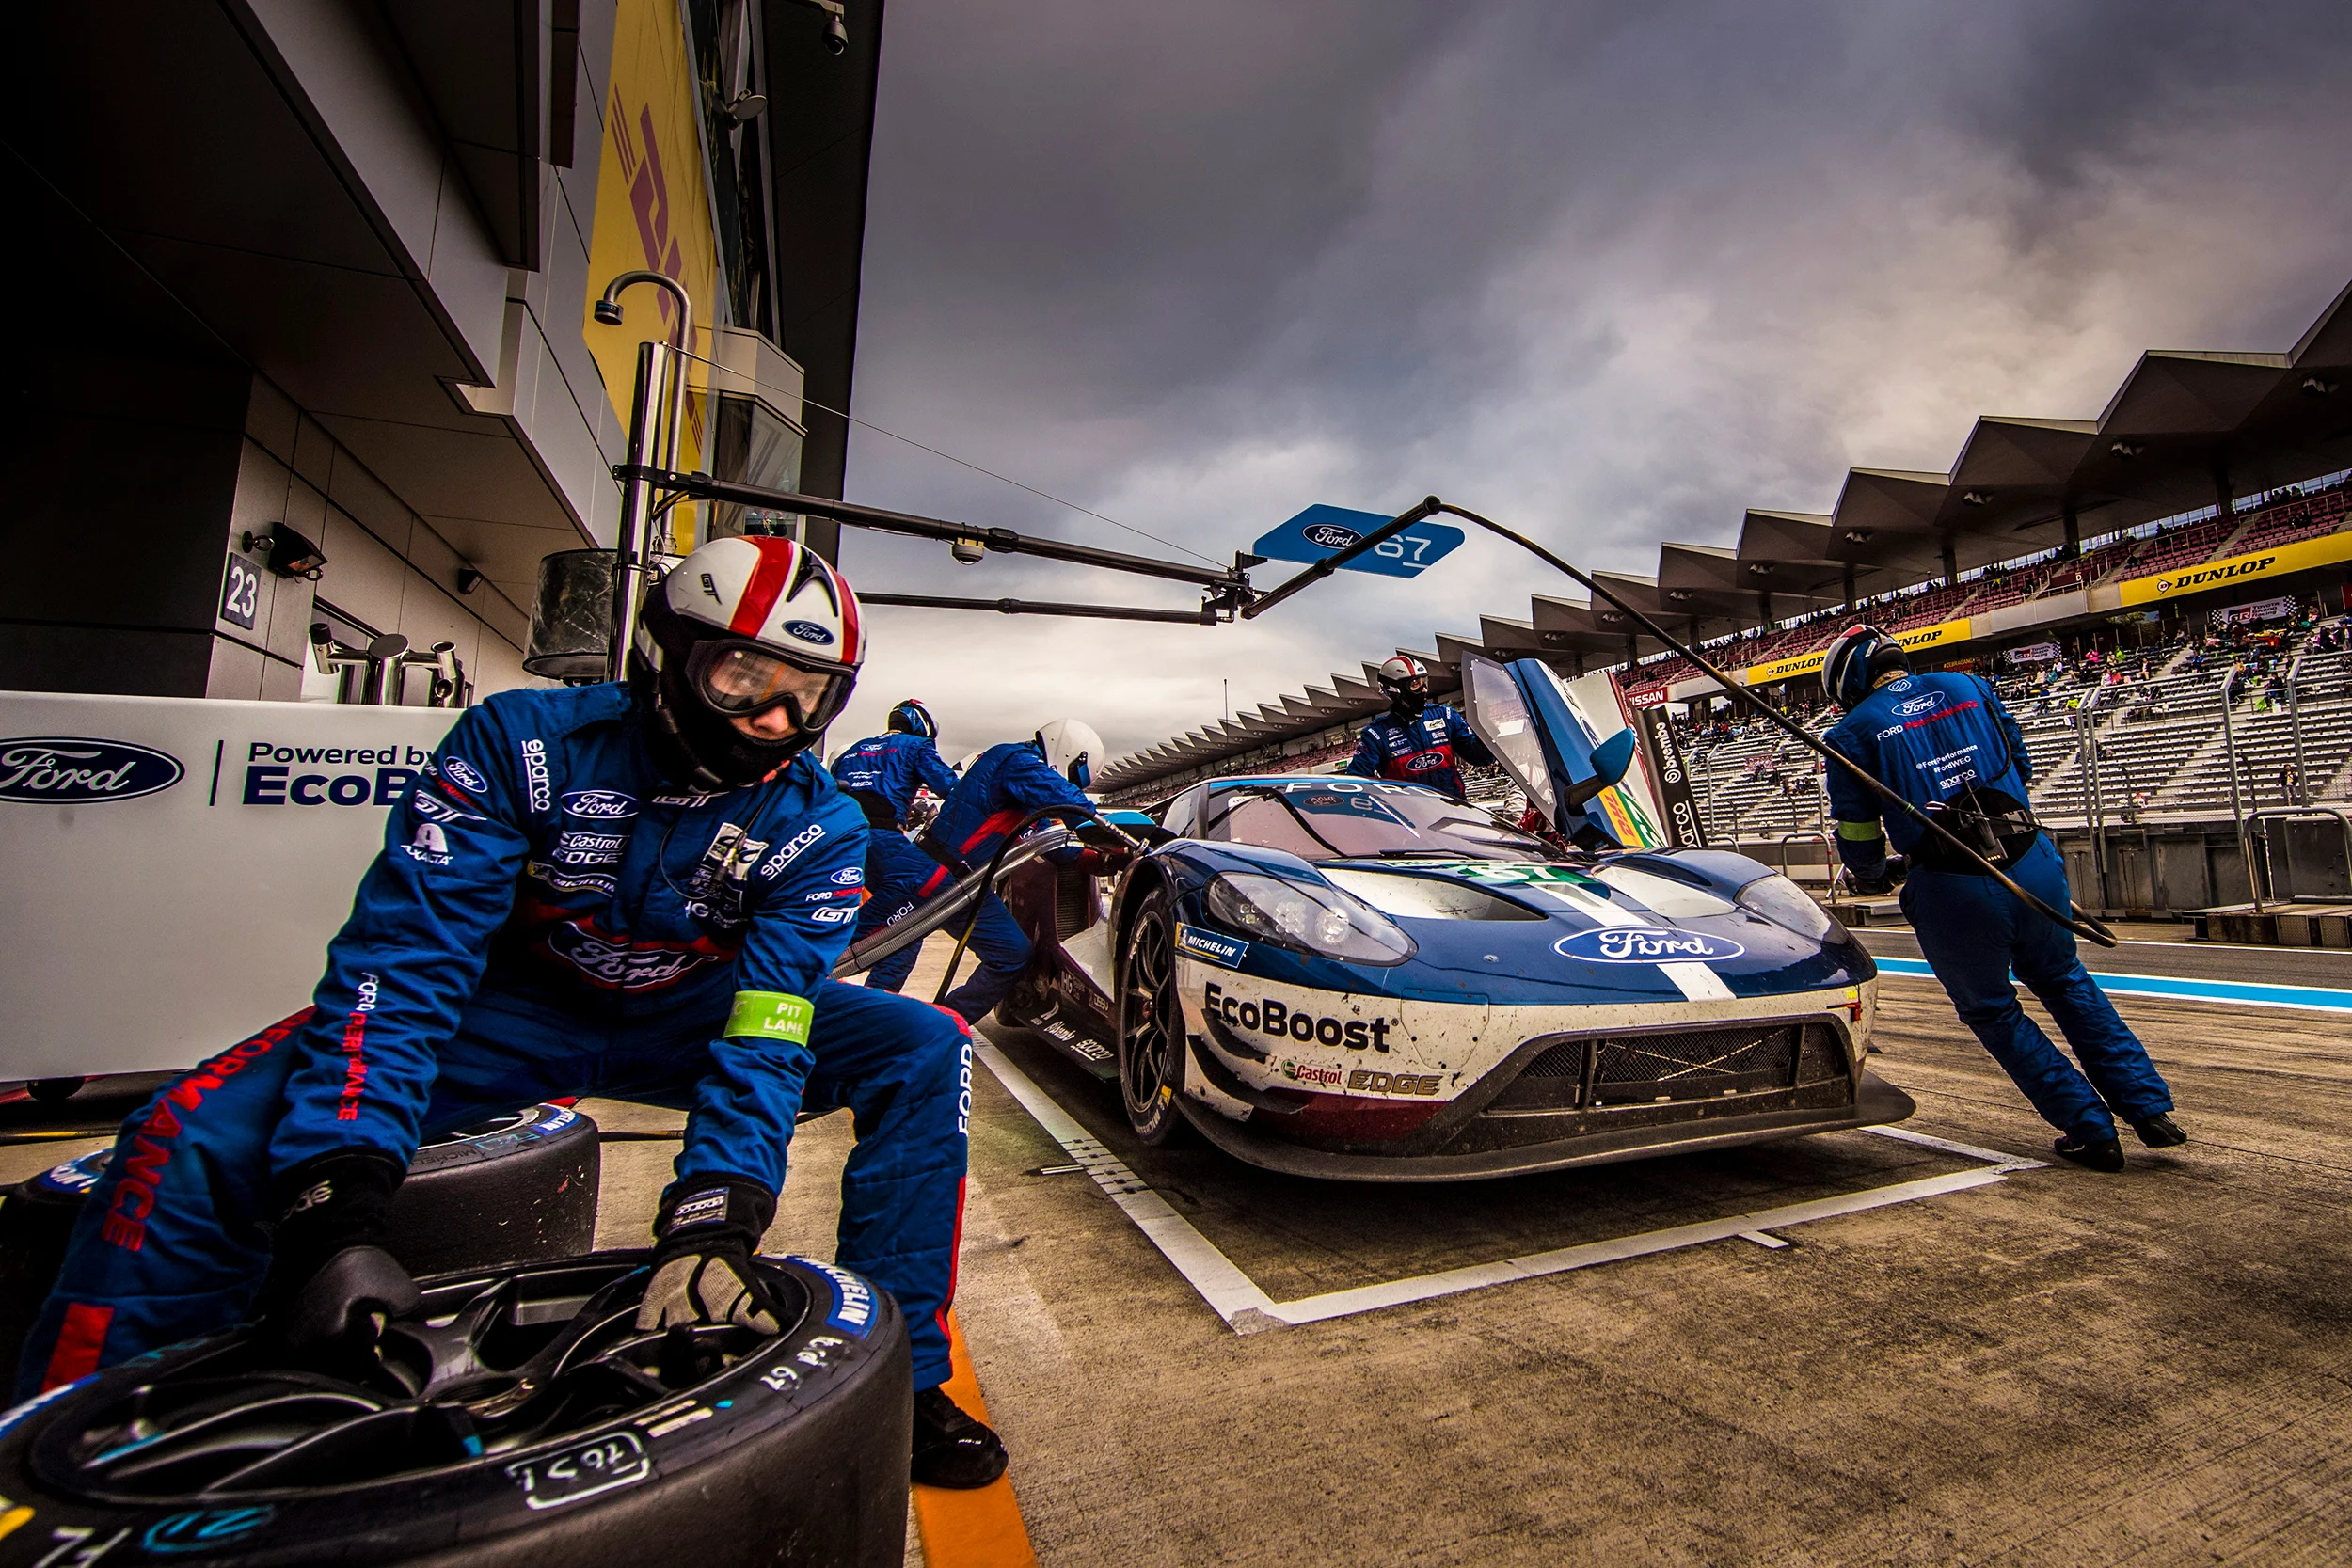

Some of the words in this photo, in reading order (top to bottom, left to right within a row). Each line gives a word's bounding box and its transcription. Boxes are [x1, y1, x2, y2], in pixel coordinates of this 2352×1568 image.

[1315, 525, 1354, 546] Ford
[1374, 534, 1431, 562] 67
[2175, 556, 2276, 589] DUNLOP
[227, 566, 257, 618] 23
[792, 621, 825, 643] Ford
[1897, 630, 1942, 646] NLOP
[1775, 657, 1825, 673] DUNLOP
[1629, 690, 1664, 706] ISSAN
[1903, 697, 1935, 713] Ford
[1876, 724, 1904, 741] FORD
[1904, 700, 1978, 731] PERFORMANCE
[247, 741, 402, 765] Powered
[1655, 721, 1678, 770] brembo
[0, 748, 137, 791] Ford
[1414, 755, 1438, 768] Ford
[448, 762, 479, 786] Ford
[521, 739, 551, 813] sparco
[1285, 782, 1454, 800] FORD
[572, 792, 626, 816] Ford
[1673, 800, 1702, 847] arco
[568, 834, 622, 850] Castrol
[760, 824, 827, 880] sparco
[401, 845, 453, 865] AXALTA
[553, 850, 620, 864] EDGE
[553, 878, 616, 893] MICHELIN
[805, 891, 833, 902] FORD
[1187, 935, 1236, 958] MICHELIN
[1599, 929, 1715, 958] Ford
[570, 941, 688, 982] Ford
[355, 972, 379, 1011] FORD
[777, 1003, 802, 1018] PIT
[1205, 981, 1391, 1053] EcoBoost
[763, 1017, 803, 1036] LANE
[1295, 1065, 1343, 1085] Castrol
[1347, 1070, 1443, 1096] EDGE
[959, 1043, 973, 1137] FORD
